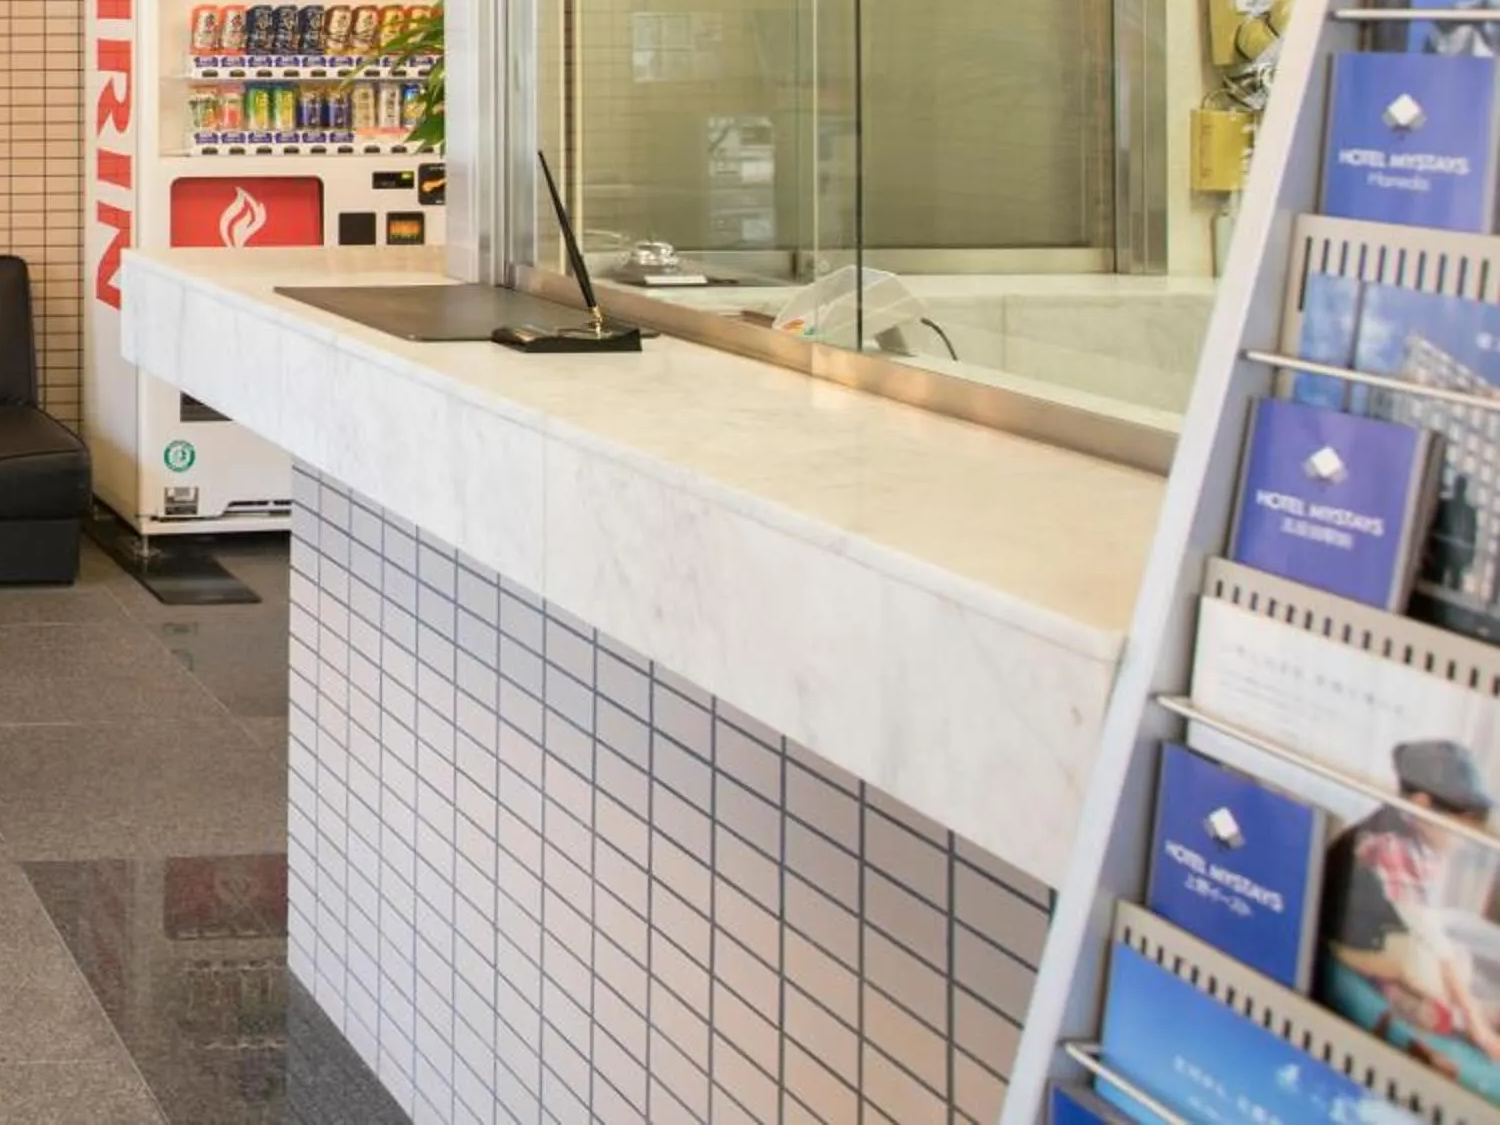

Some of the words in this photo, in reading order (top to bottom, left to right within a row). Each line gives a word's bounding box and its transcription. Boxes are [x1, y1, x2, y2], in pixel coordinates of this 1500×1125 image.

[1339, 148, 1386, 168] HOTEL
[1256, 489, 1305, 516] HOTEL
[1308, 504, 1384, 536] MYSTAYS
[1164, 840, 1207, 874] HOTEL
